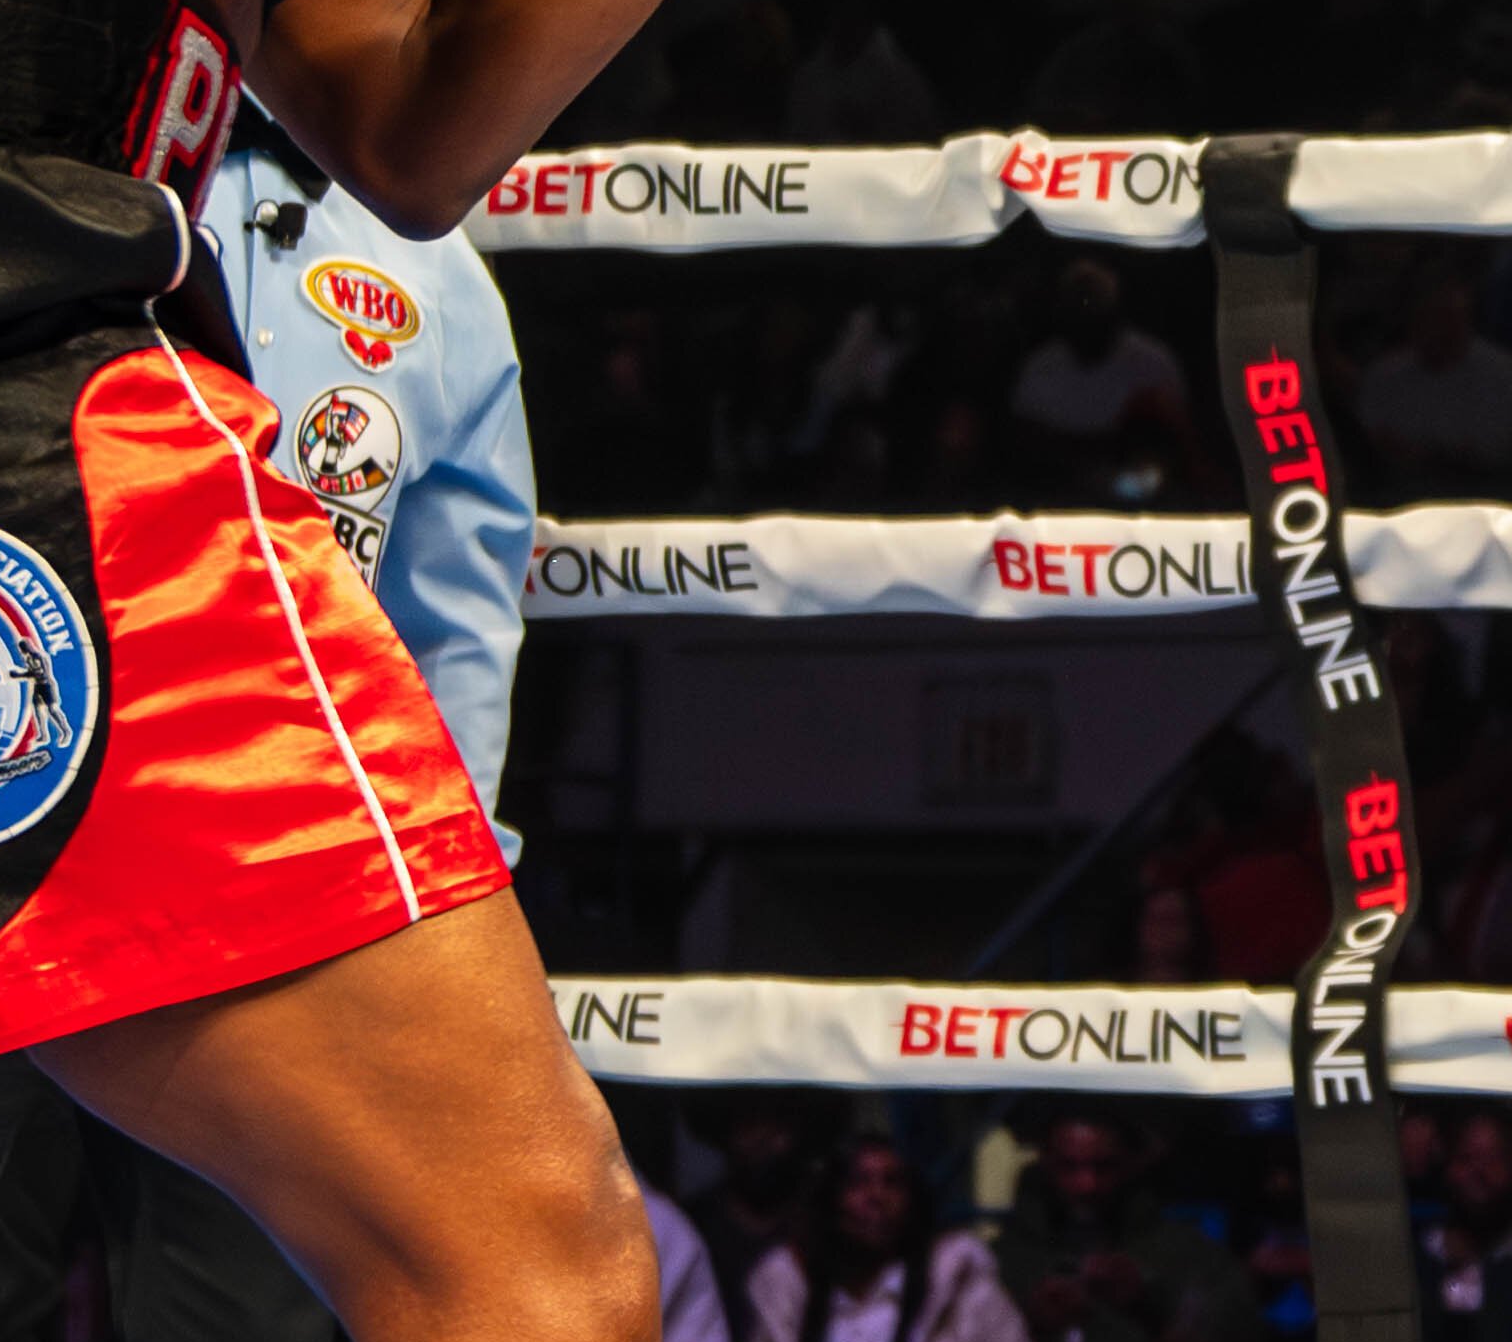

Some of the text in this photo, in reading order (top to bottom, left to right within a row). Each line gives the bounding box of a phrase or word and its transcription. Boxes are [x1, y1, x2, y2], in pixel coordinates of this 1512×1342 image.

[486, 160, 810, 218] BETONLINE
[325, 270, 410, 330] WBO
[1243, 347, 1382, 713] BETONLINE
[1311, 770, 1408, 1109] BETONLINE
[894, 1002, 1246, 1063] BETONLINE
